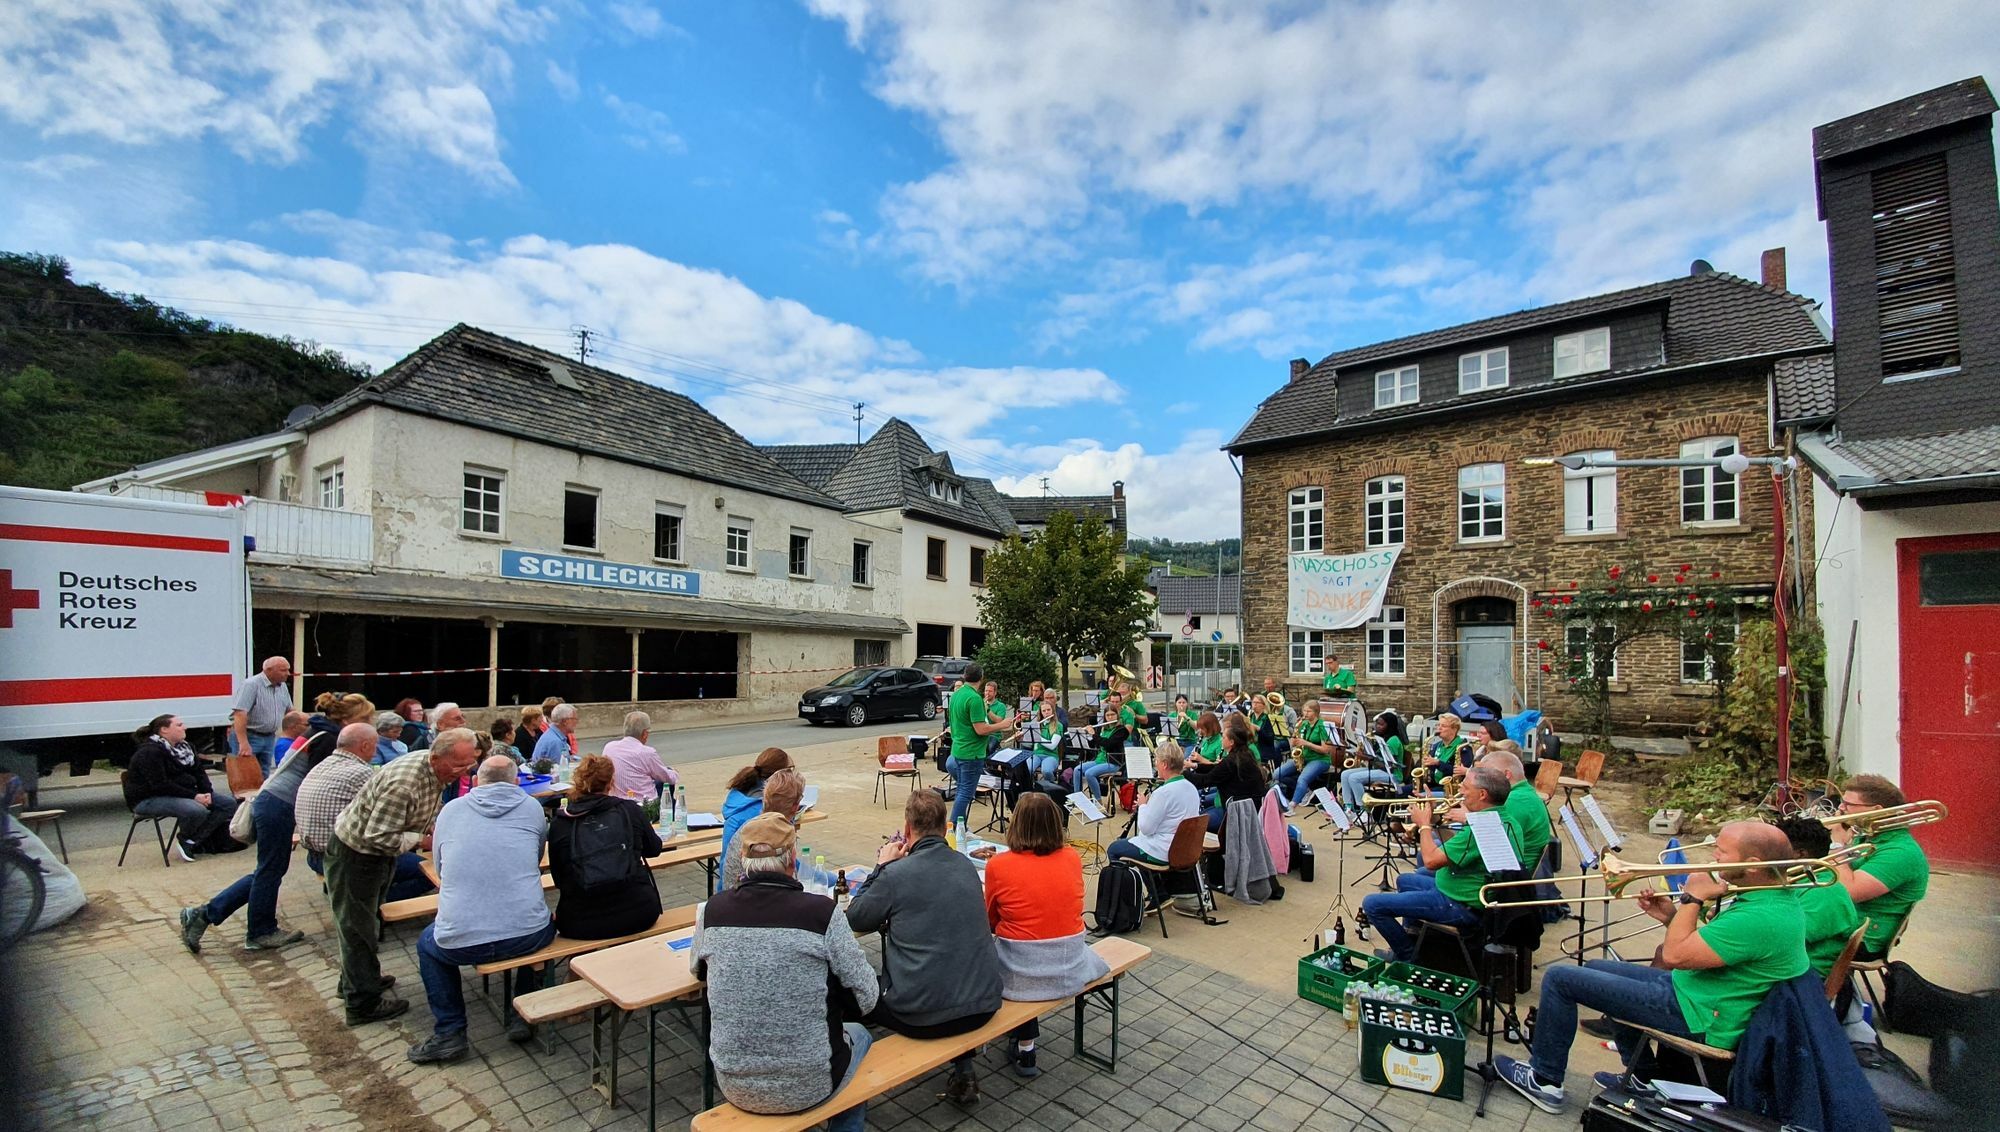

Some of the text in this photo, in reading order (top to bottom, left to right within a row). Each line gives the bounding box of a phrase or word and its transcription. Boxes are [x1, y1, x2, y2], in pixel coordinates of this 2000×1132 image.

[1292, 551, 1393, 573] MAYSCHOSS
[59, 571, 197, 592] Deutsches
[518, 556, 687, 590] SCHLECKER
[1322, 575, 1352, 587] SAGT
[59, 592, 137, 610] Rotes
[59, 612, 137, 629] Kreuz
